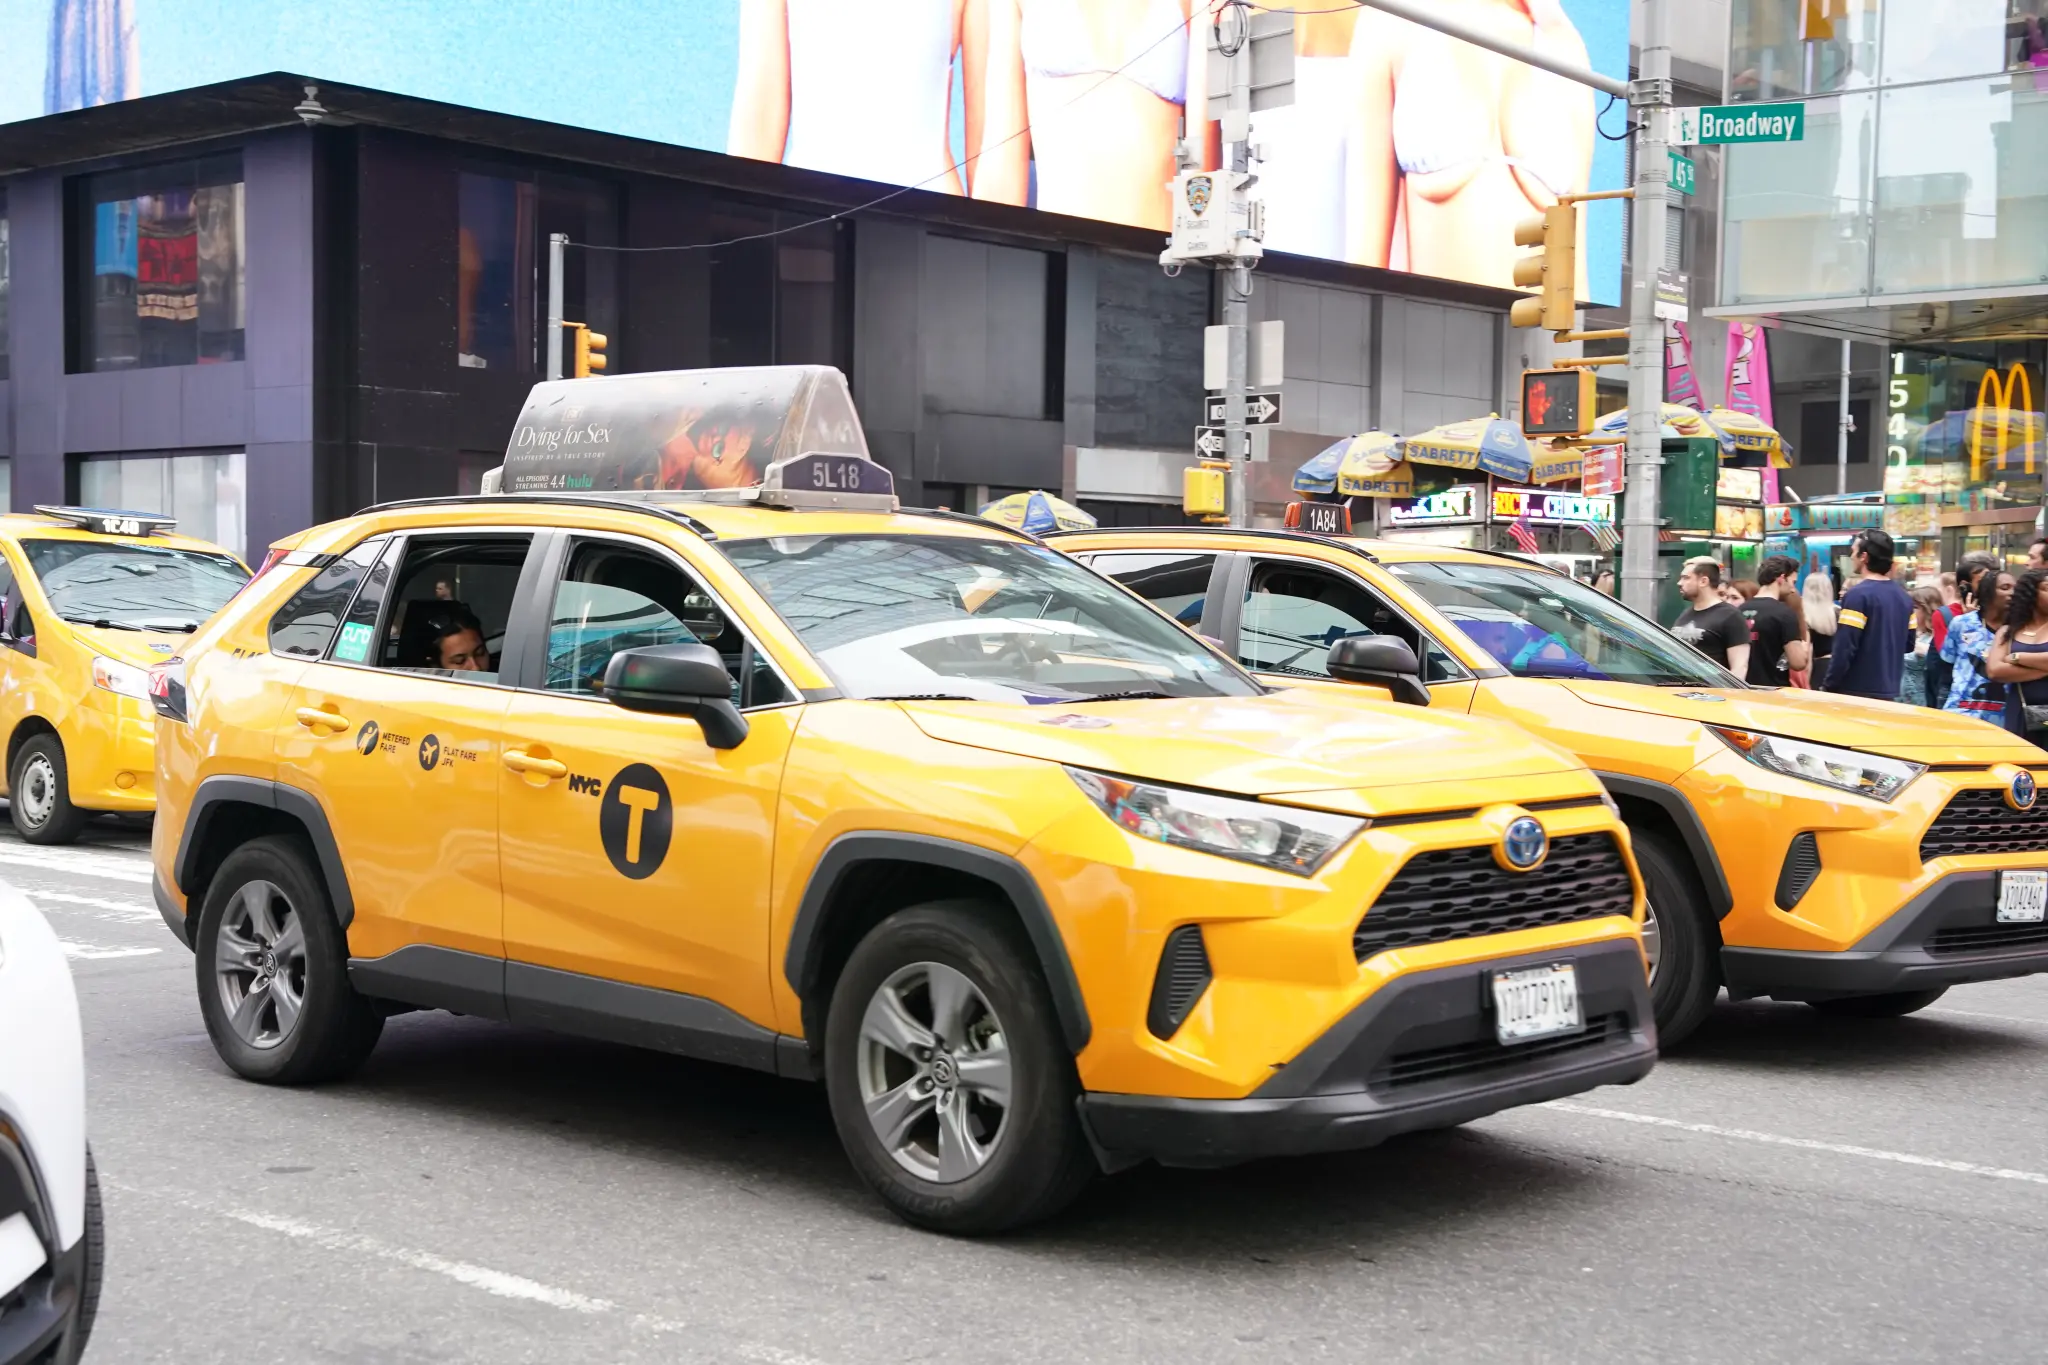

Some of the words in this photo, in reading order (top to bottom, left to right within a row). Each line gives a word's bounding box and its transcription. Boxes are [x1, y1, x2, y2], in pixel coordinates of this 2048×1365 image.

[1701, 111, 1797, 141] Broadway
[1675, 160, 1687, 188] 45
[1247, 403, 1270, 416] WAY
[517, 426, 563, 454] Dying
[563, 424, 585, 445] for
[584, 423, 613, 444] Sex
[1409, 445, 1475, 463] SABRETT
[525, 474, 549, 482] EPISODES
[550, 474, 565, 488] 4.4
[566, 473, 593, 488] hulu
[813, 462, 860, 489] 5L18
[1343, 478, 1410, 493] SABRETT
[102, 518, 140, 535] 1C40
[1310, 508, 1336, 532] 1A84
[341, 625, 371, 644] curb
[382, 732, 410, 746] METERED
[380, 743, 396, 754] FARE
[443, 746, 460, 756] FLAT
[460, 750, 477, 762] FARE
[441, 758, 454, 768] JFK
[569, 773, 602, 797] NYC
[619, 784, 660, 864] T
